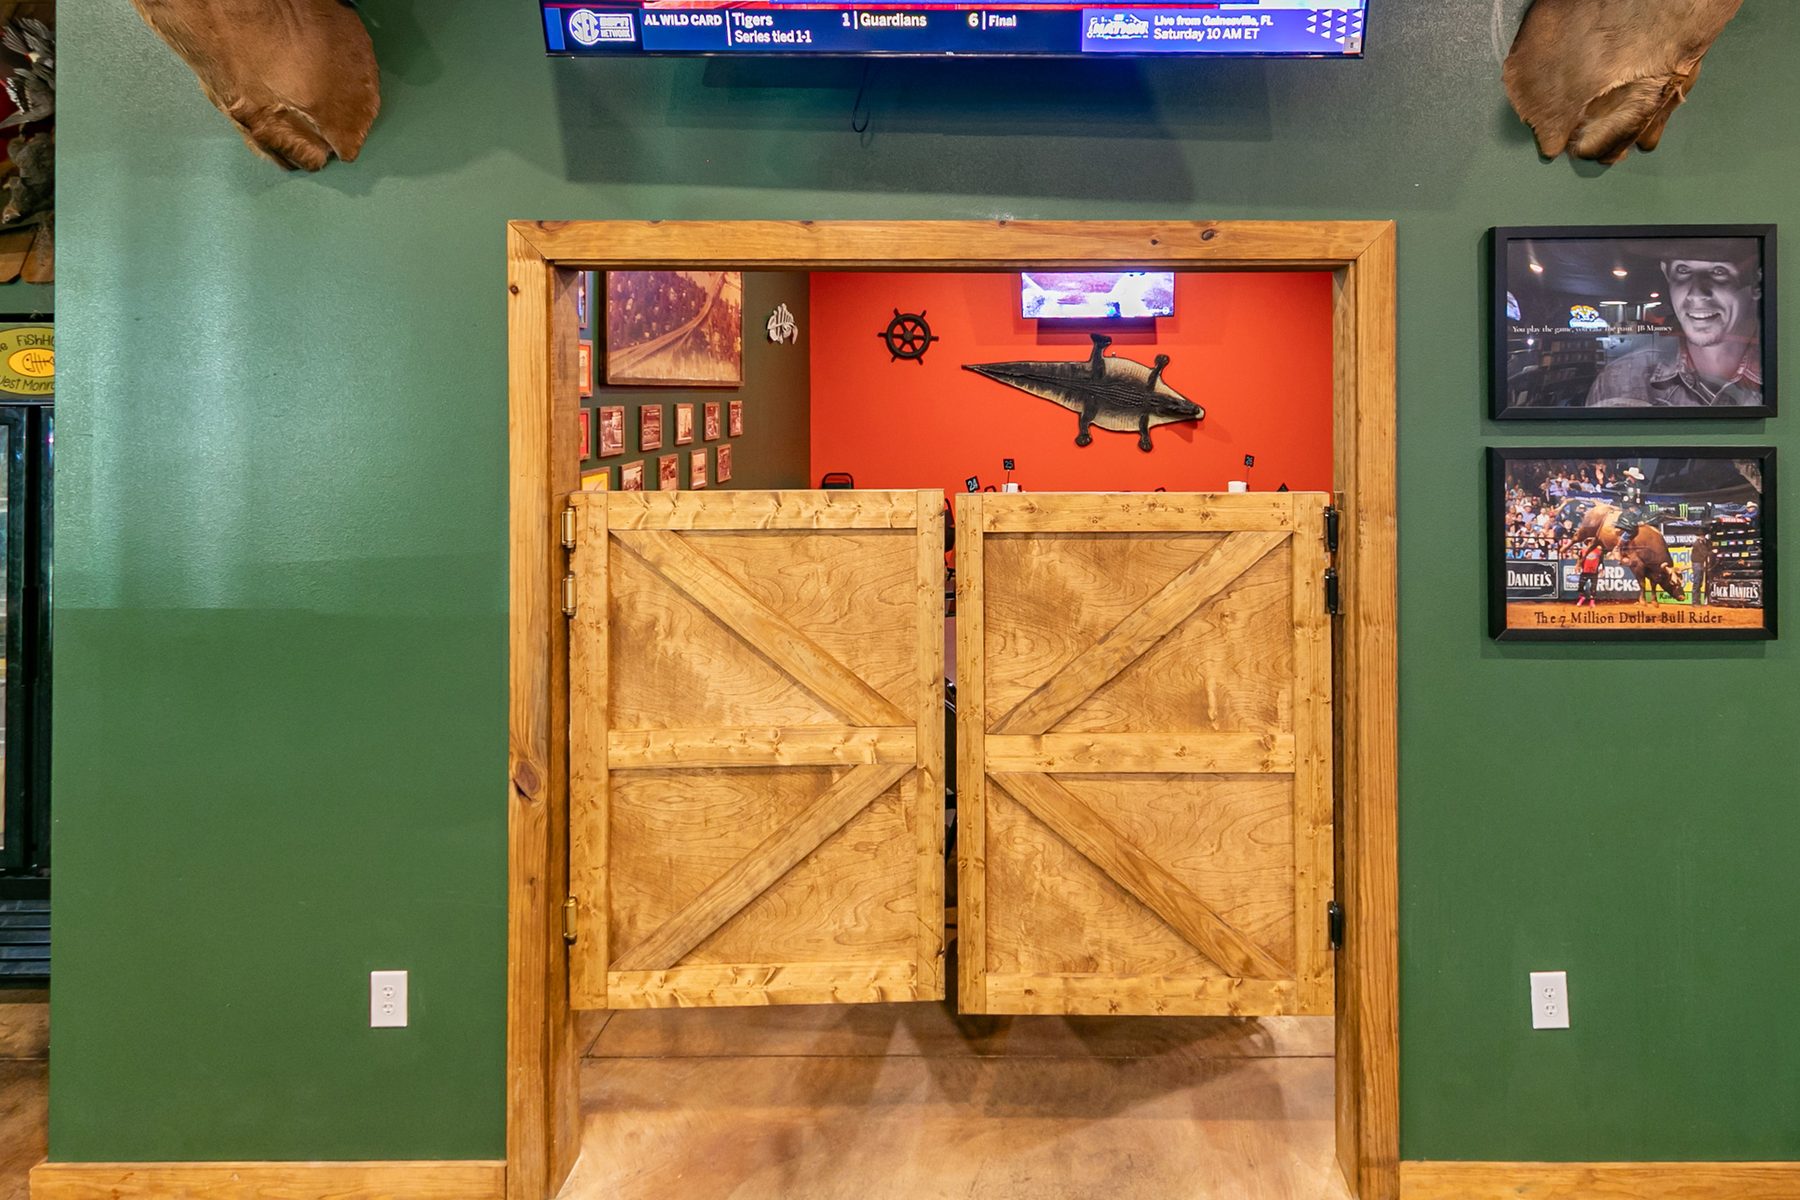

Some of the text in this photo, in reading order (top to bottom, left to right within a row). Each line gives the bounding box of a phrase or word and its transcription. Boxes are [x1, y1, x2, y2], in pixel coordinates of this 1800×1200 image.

[644, 14, 722, 26] AL WILD CARD
[732, 12, 850, 28] Tigers 1
[860, 13, 978, 26] Guardians 6
[988, 15, 1017, 26] Final
[1154, 15, 1274, 27] Live from Gainesville, FL
[572, 11, 600, 42] SEC
[735, 29, 812, 43] Series tied 1-1
[1154, 28, 1260, 41] Saturday 10 AM ET
[1512, 325, 1525, 333] You
[1527, 324, 1540, 335] play
[1542, 324, 1552, 333] the
[967, 478, 979, 491] 24
[1507, 570, 1552, 587] DANIEL'S
[1596, 579, 1641, 591] RUCKS
[1711, 583, 1759, 598] JACK DANIEL'S
[1535, 611, 1556, 624] The
[1570, 611, 1615, 624] Million
[1619, 611, 1656, 624] Dollar
[1661, 611, 1685, 624] Bull
[1689, 611, 1722, 624] Rider
